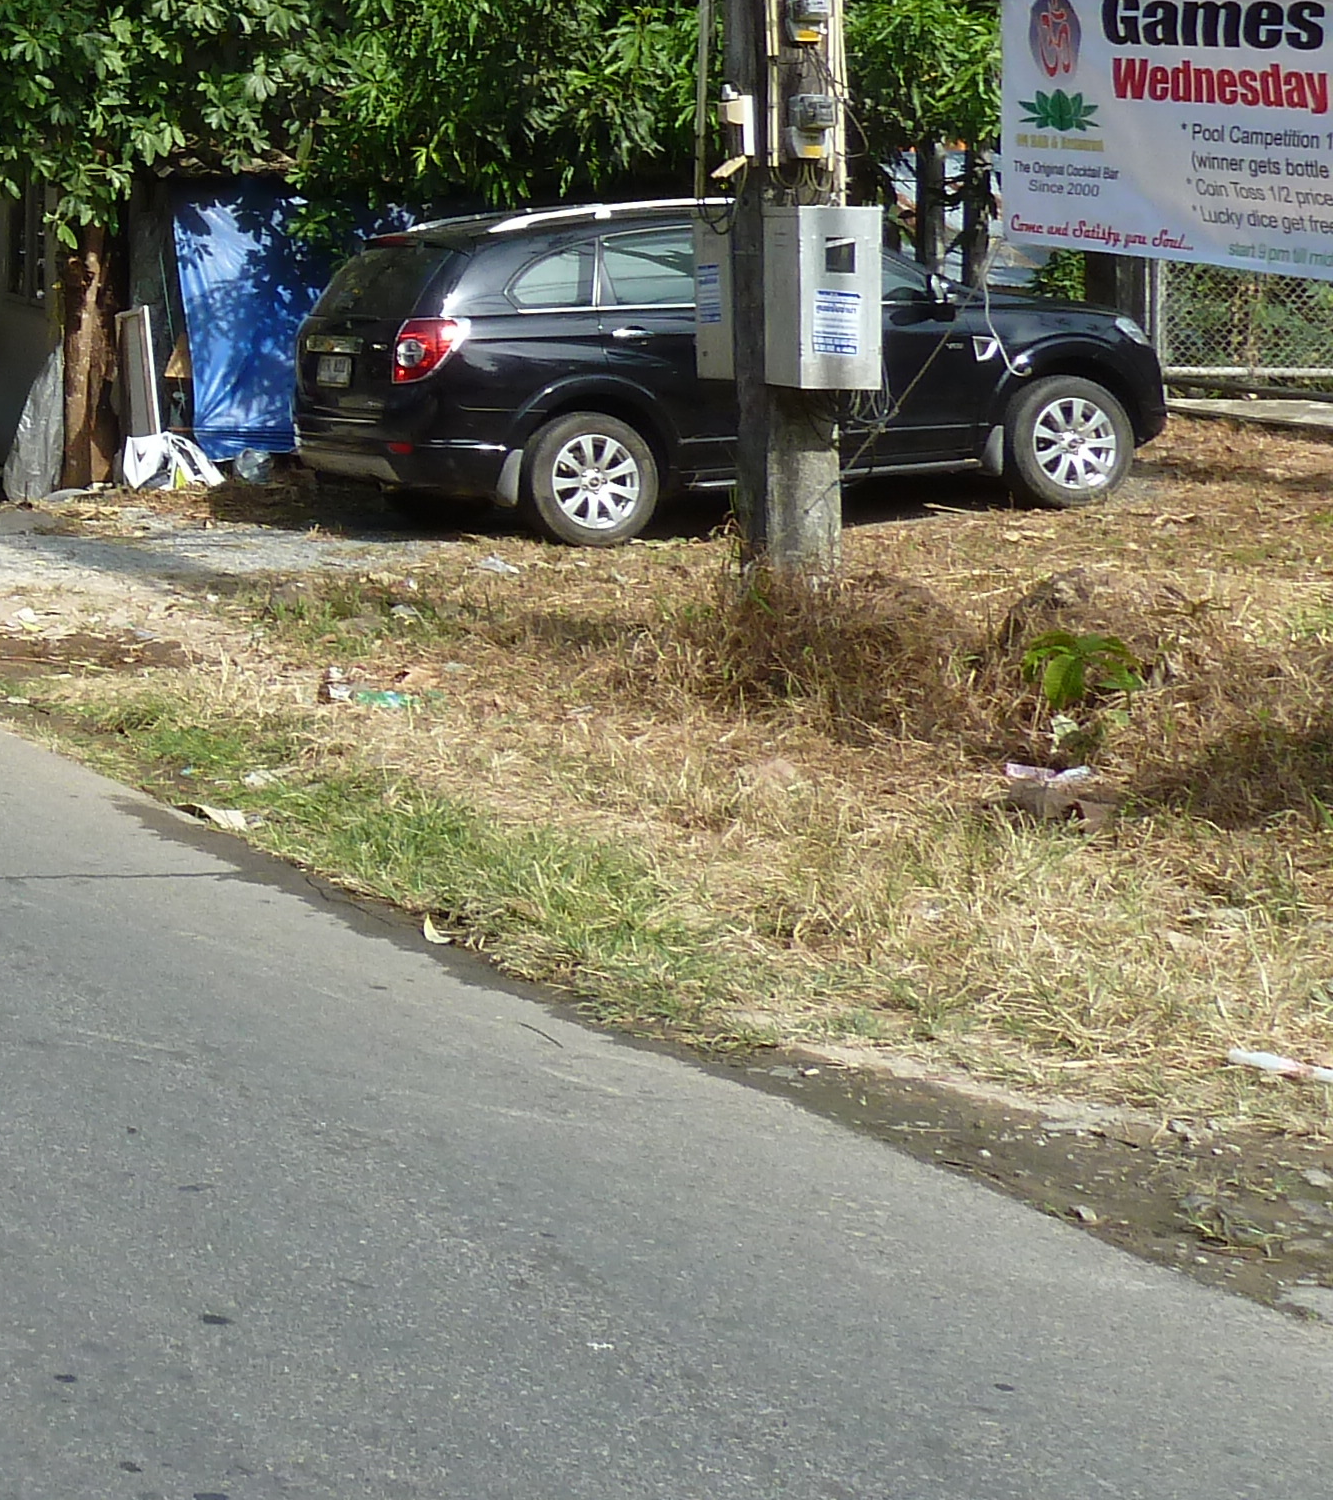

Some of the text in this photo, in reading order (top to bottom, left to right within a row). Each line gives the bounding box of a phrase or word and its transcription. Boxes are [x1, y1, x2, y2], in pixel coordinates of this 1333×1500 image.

[1112, 57, 1328, 114] Wednesday
[1192, 123, 1224, 143] Pool
[1014, 159, 1120, 180] The Original Cocktail Bar
[1192, 150, 1329, 179] (winner gets bottle
[1028, 179, 1100, 197] Since 2000
[1195, 178, 1228, 197] Coin
[1229, 181, 1266, 201] Toss
[1268, 186, 1293, 203] 1/2
[1010, 213, 1044, 235] Come
[1046, 221, 1069, 237] and
[1072, 220, 1121, 247] Satisfy
[1124, 232, 1148, 249] you
[1199, 205, 1243, 229] Lucky
[1247, 210, 1278, 228] dice
[1281, 216, 1307, 234] get
[1228, 242, 1255, 258] start
[1268, 247, 1290, 264] pm
